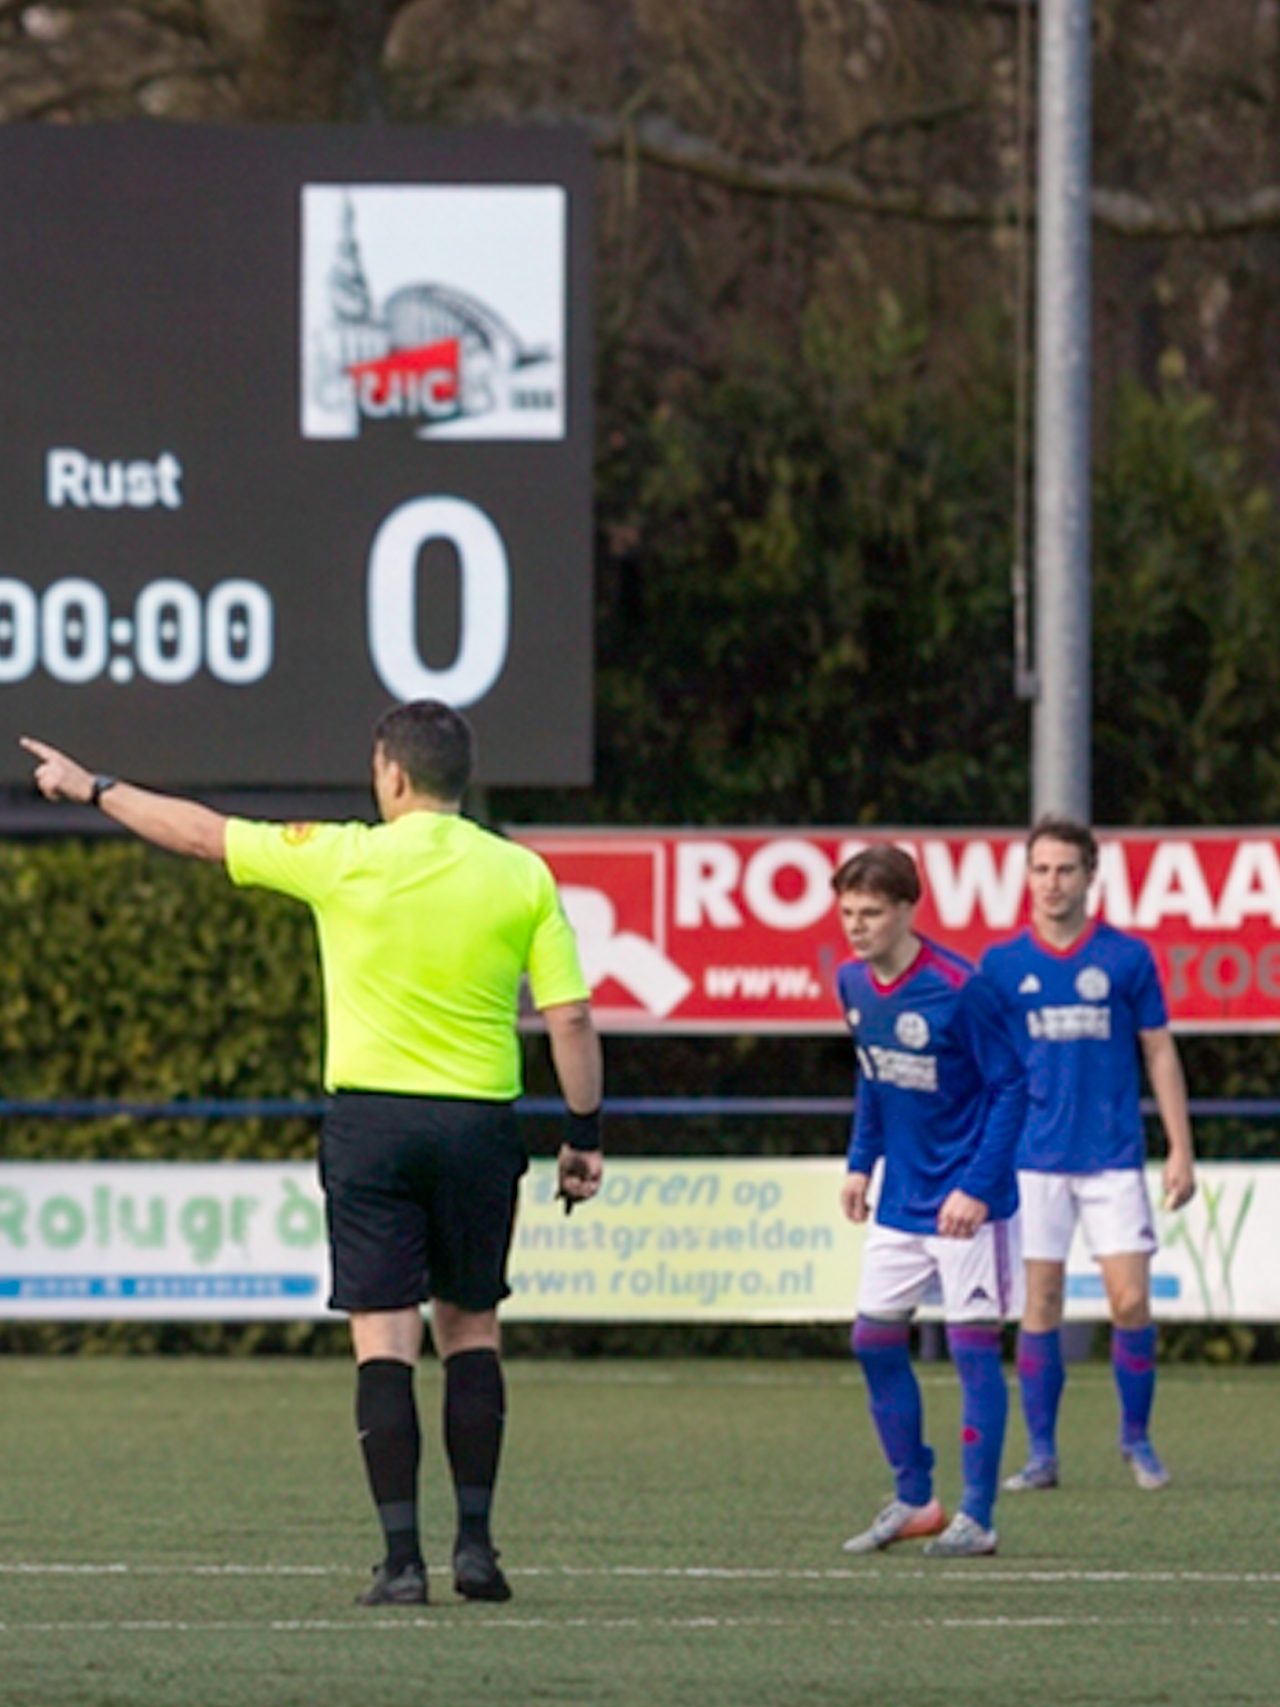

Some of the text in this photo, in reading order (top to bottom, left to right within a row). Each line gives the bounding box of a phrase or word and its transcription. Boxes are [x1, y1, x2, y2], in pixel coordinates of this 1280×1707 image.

[46, 450, 182, 507] Rust
[367, 496, 511, 710] 0
[733, 1178, 782, 1212] op
